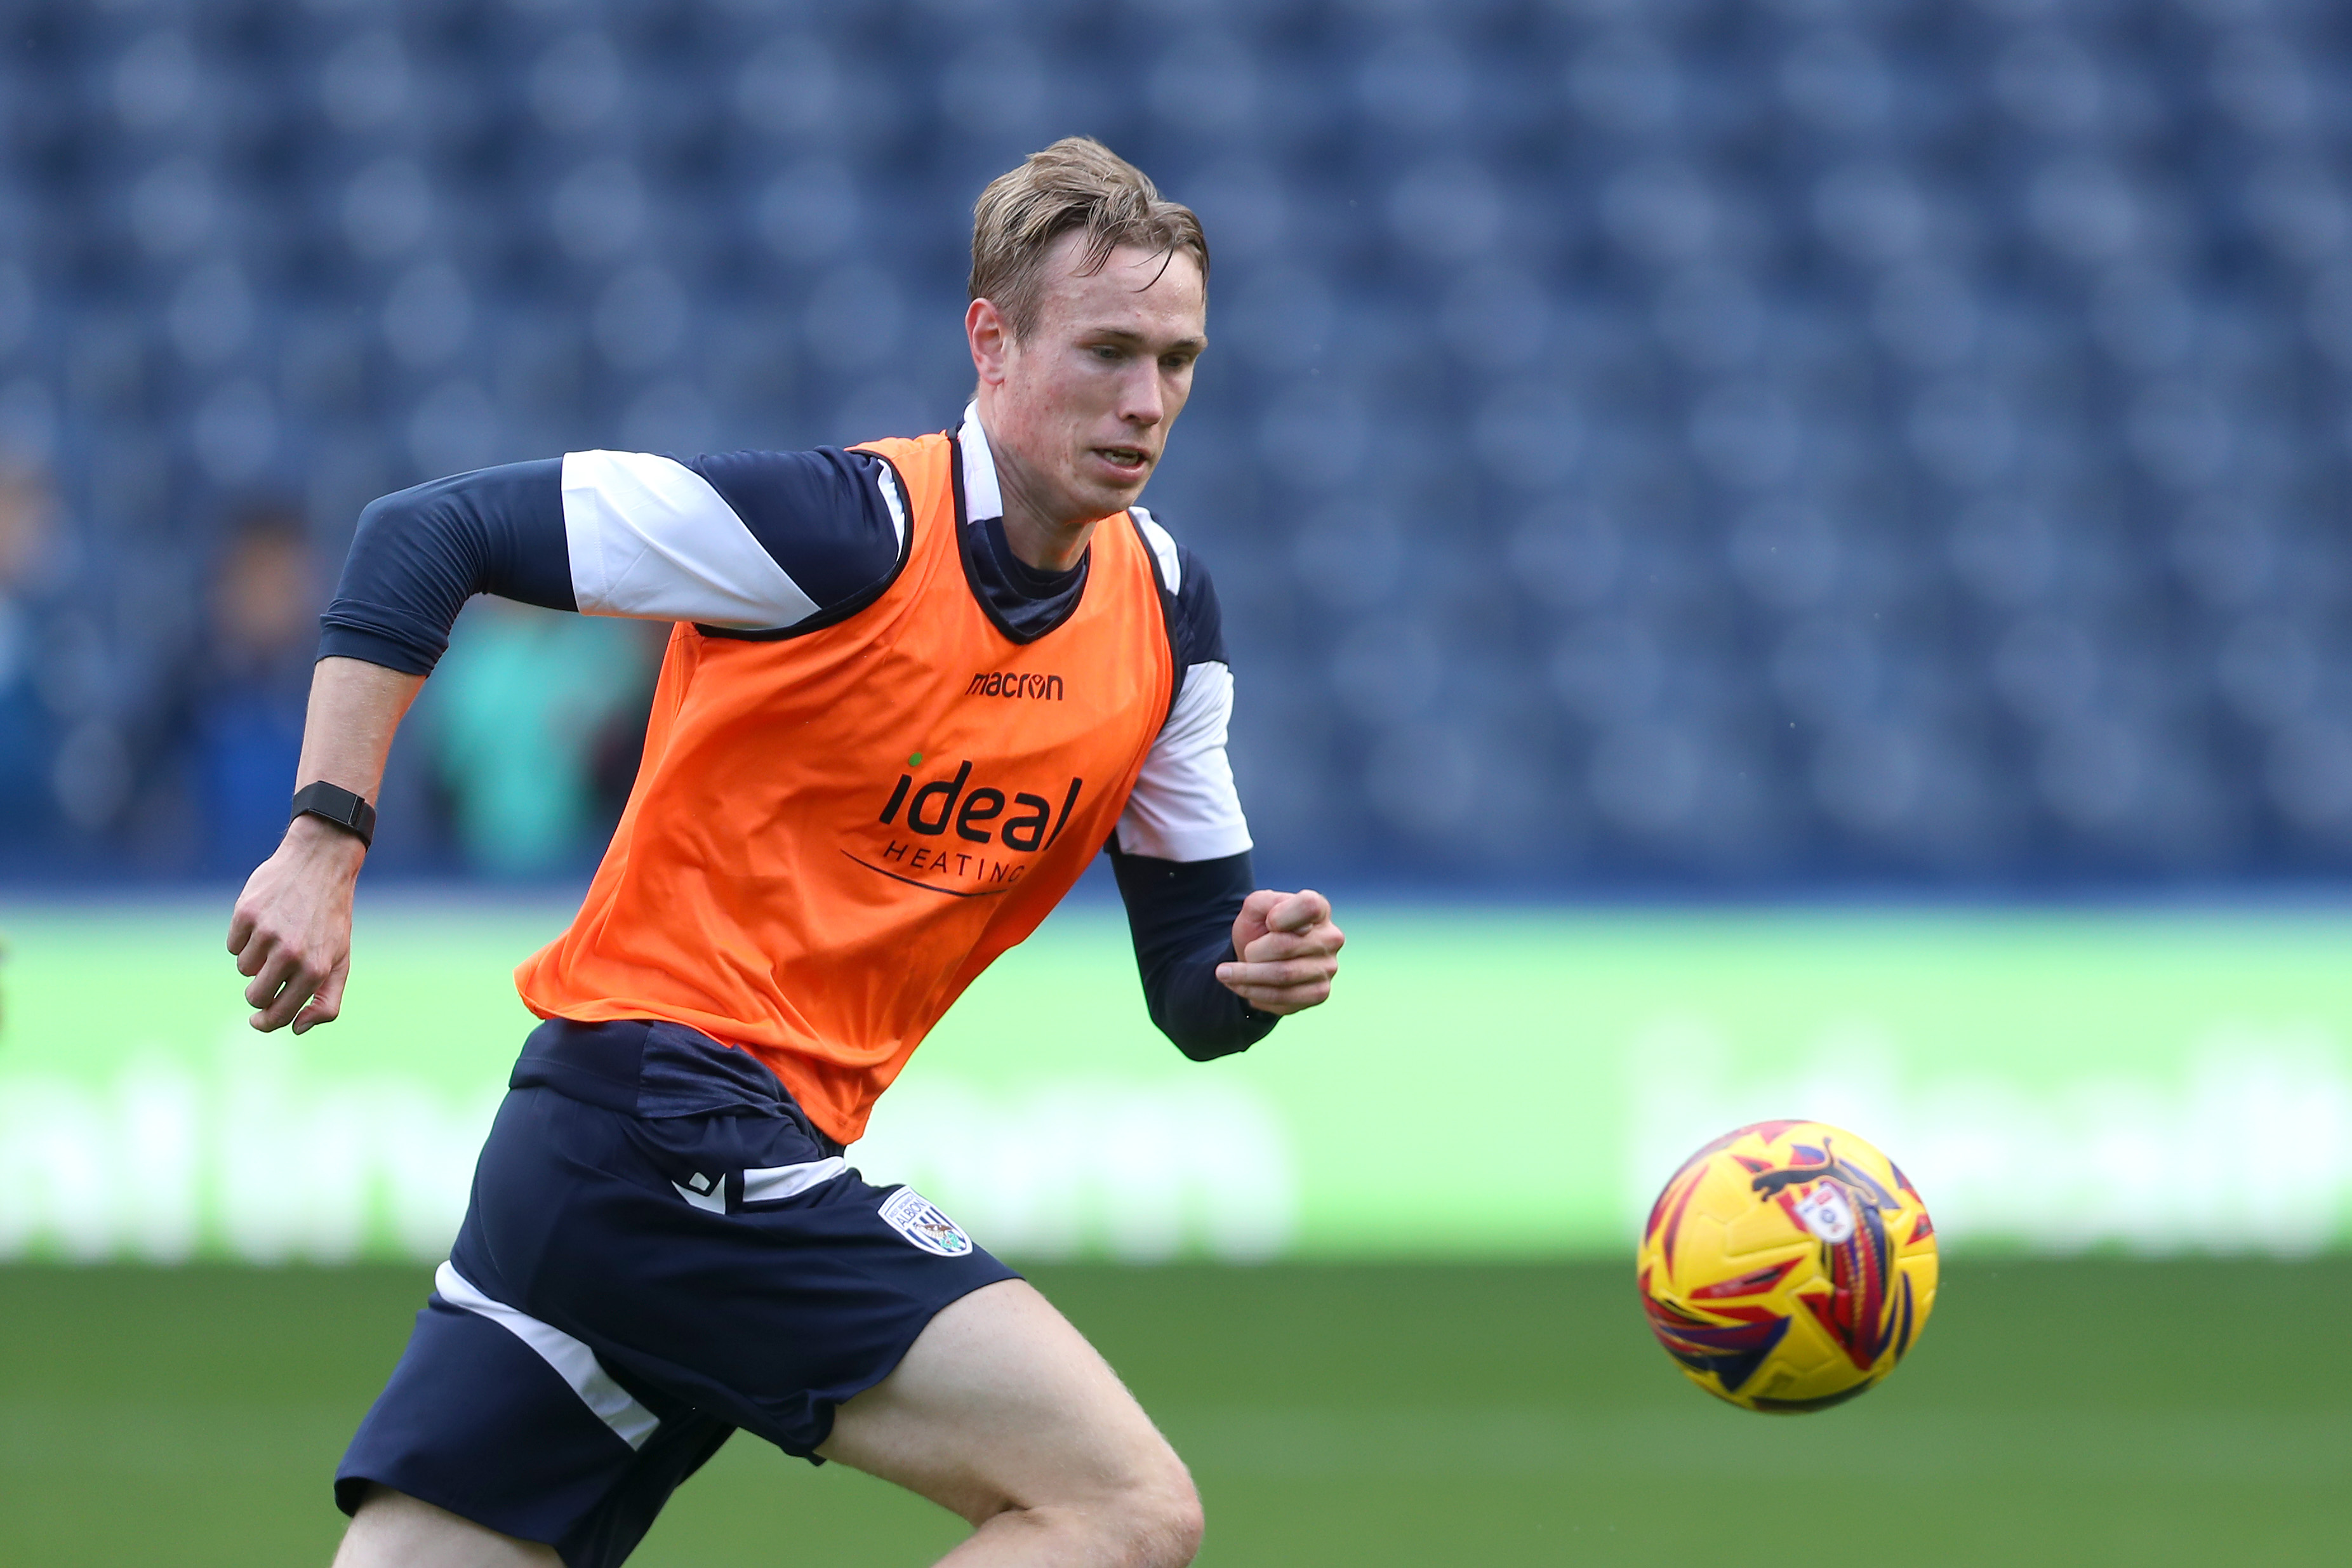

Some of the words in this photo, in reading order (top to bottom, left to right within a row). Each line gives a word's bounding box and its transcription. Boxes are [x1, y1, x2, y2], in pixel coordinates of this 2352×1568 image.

[965, 672, 1063, 700] macron
[879, 752, 1082, 853] ideal
[896, 1199, 926, 1227] ALBION
